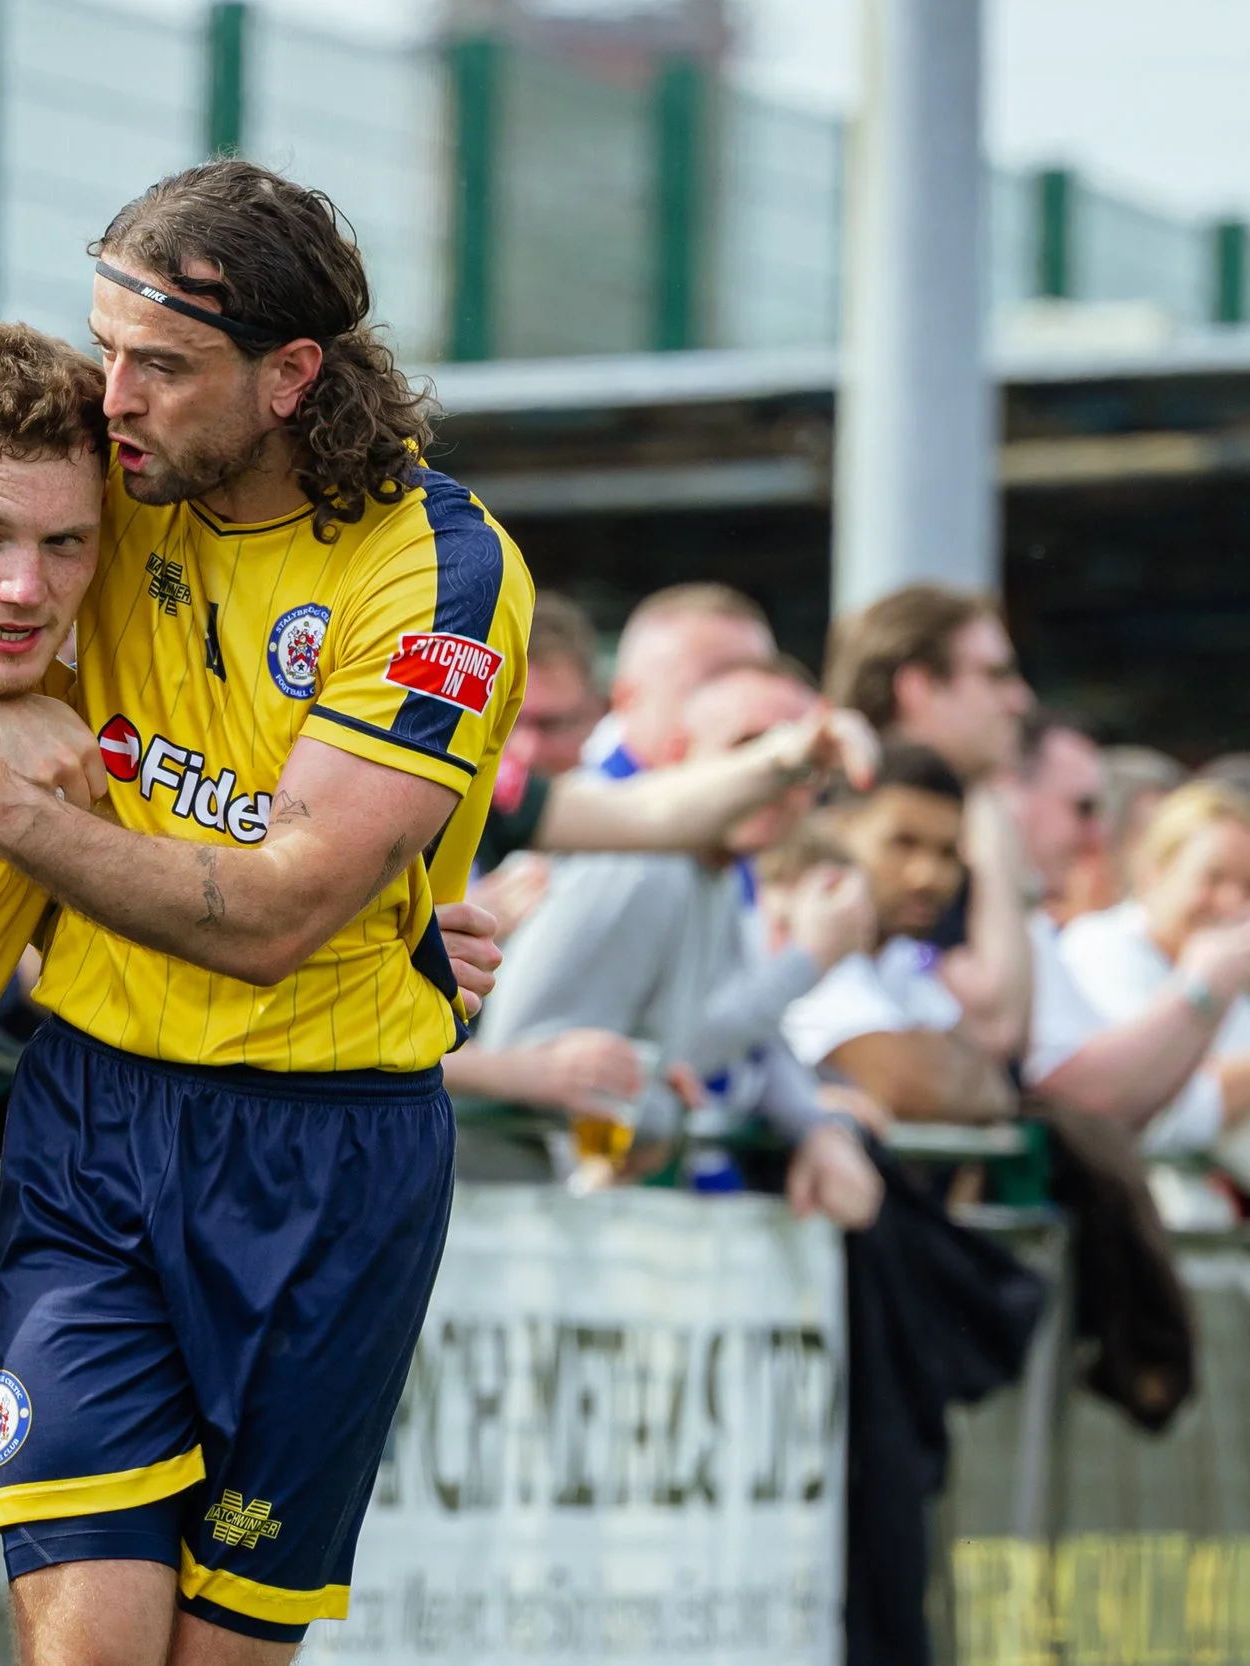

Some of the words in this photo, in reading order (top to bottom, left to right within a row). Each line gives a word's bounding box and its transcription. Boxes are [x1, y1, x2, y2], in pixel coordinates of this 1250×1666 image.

[140, 286, 168, 303] NIKE
[410, 638, 492, 681] PITCHING
[275, 673, 309, 698] FOOTBALL
[440, 664, 466, 698] IN
[4, 1376, 23, 1400] CELTIC
[3, 1438, 20, 1458] CLUB
